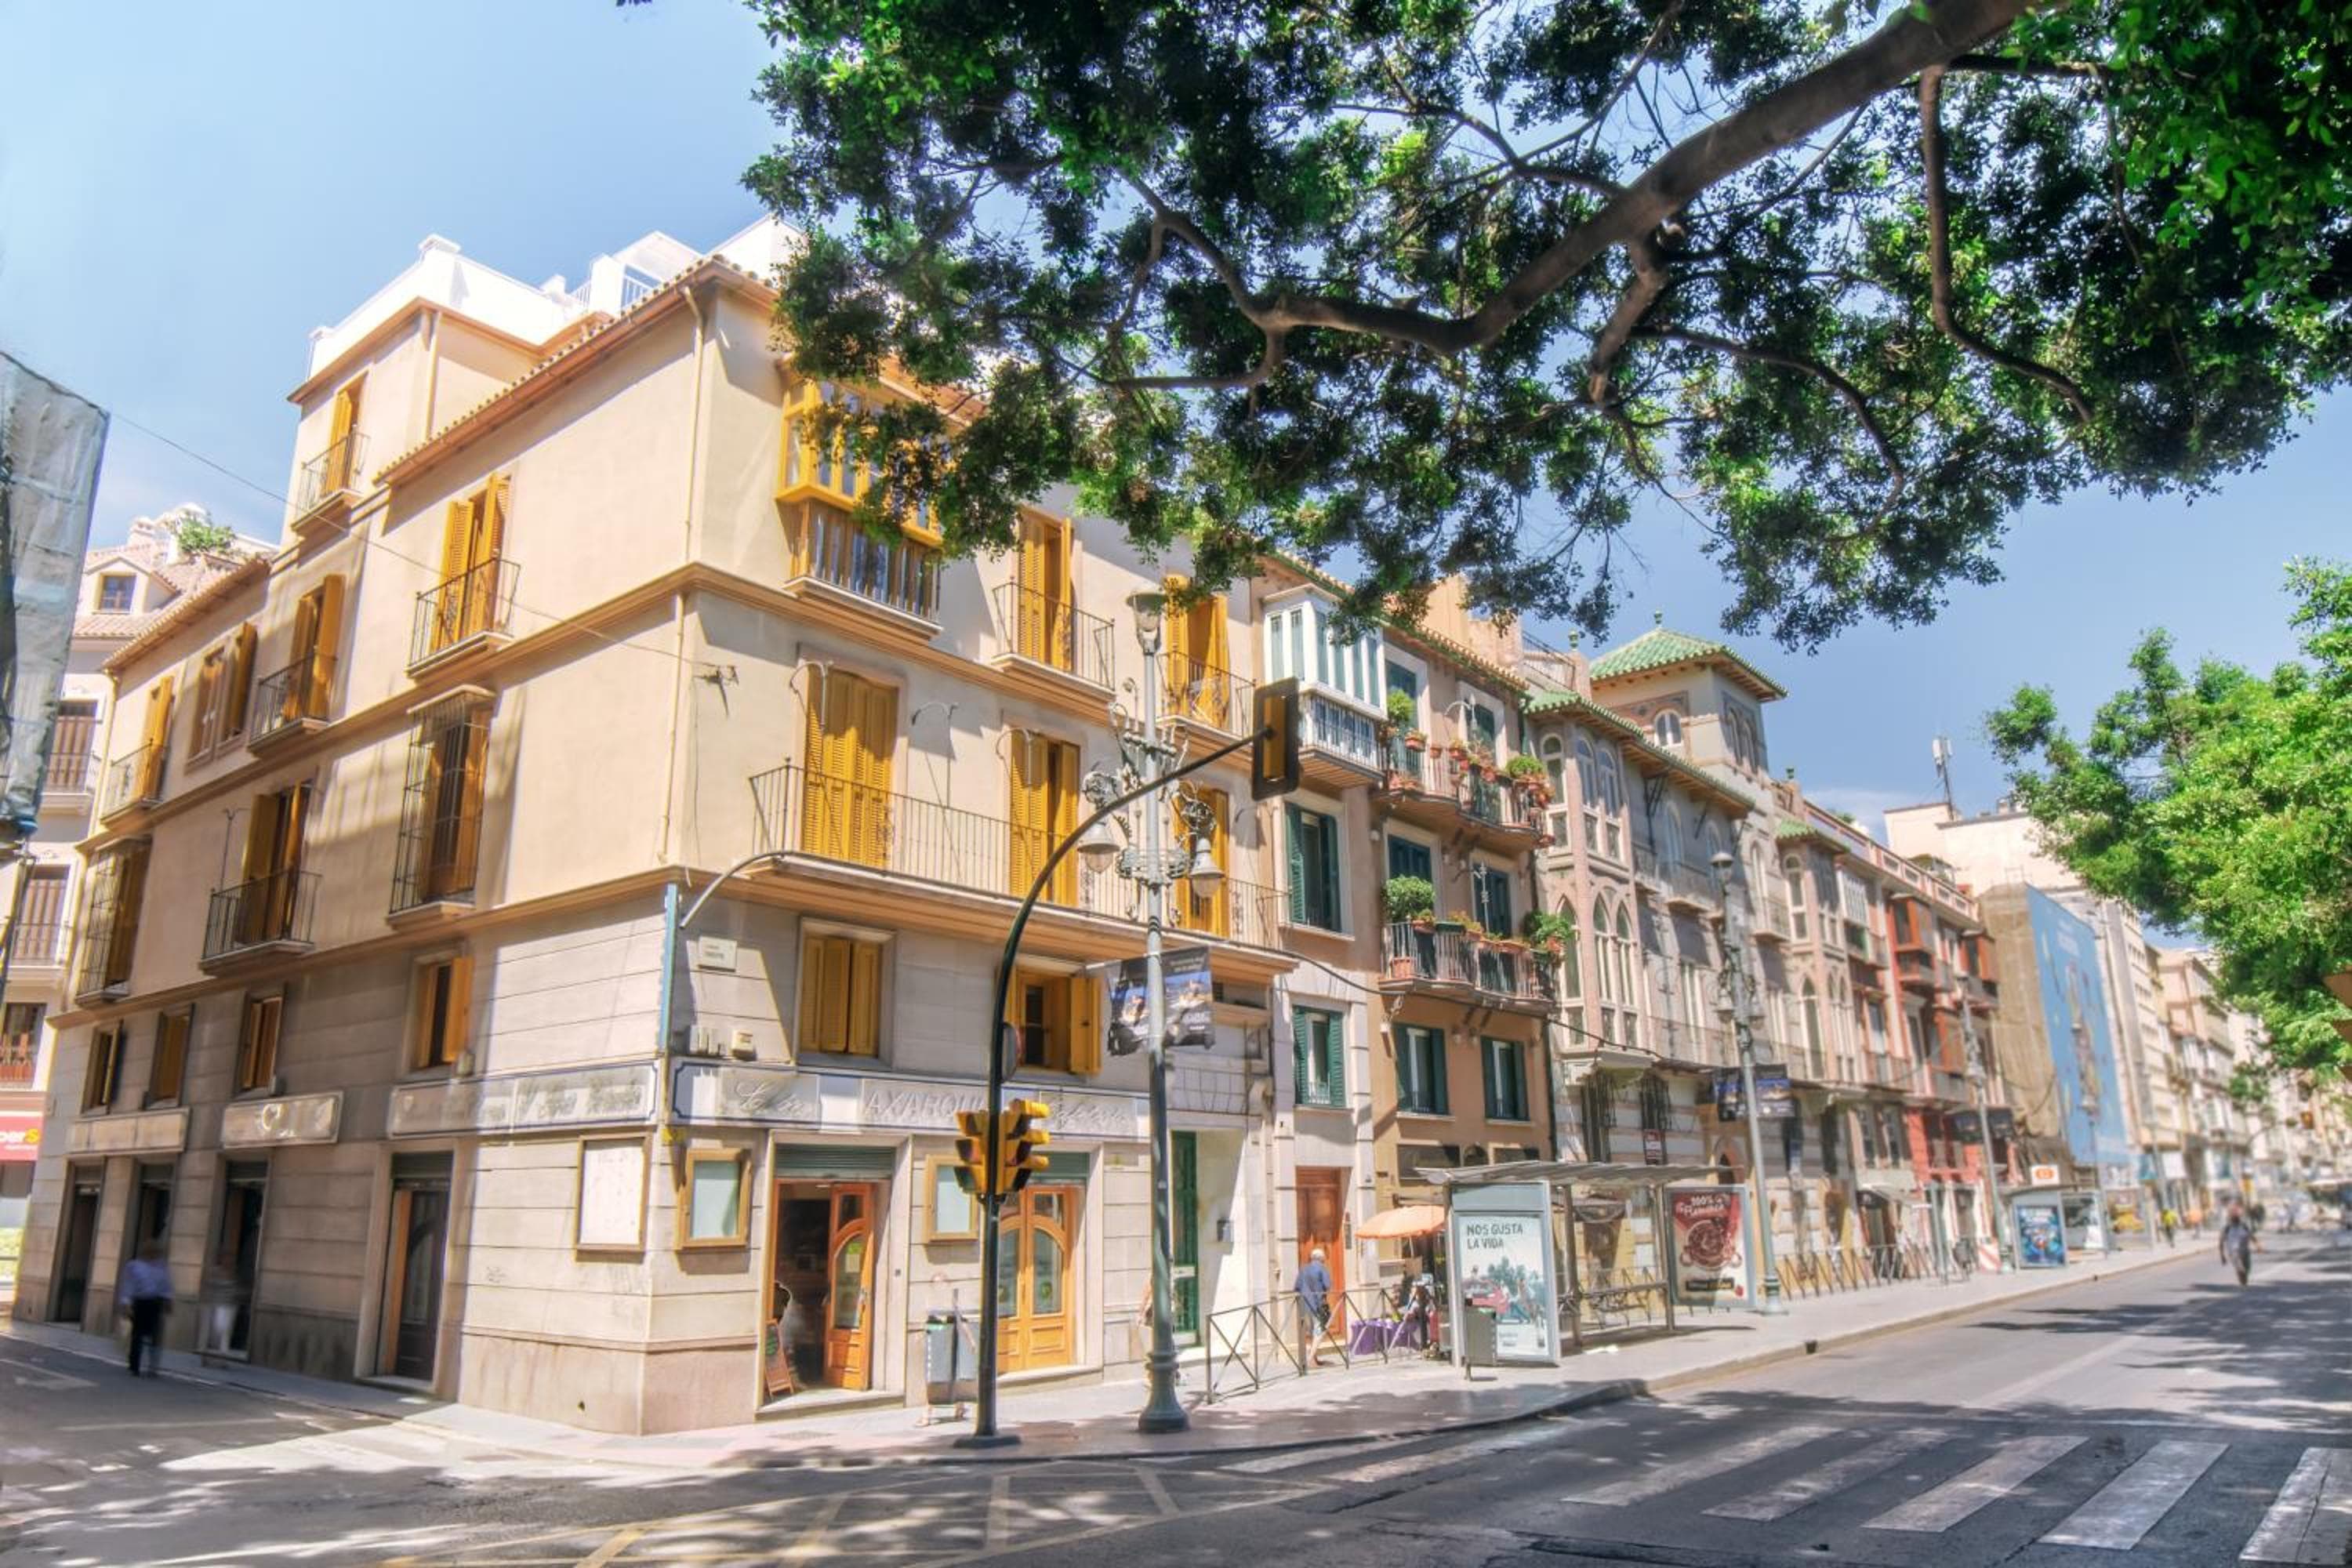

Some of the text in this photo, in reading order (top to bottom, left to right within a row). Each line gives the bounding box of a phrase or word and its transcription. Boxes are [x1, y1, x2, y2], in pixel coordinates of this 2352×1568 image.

[1467, 1223, 1524, 1236] NOS GUSTA
[1467, 1237, 1504, 1250] LA VIDA
